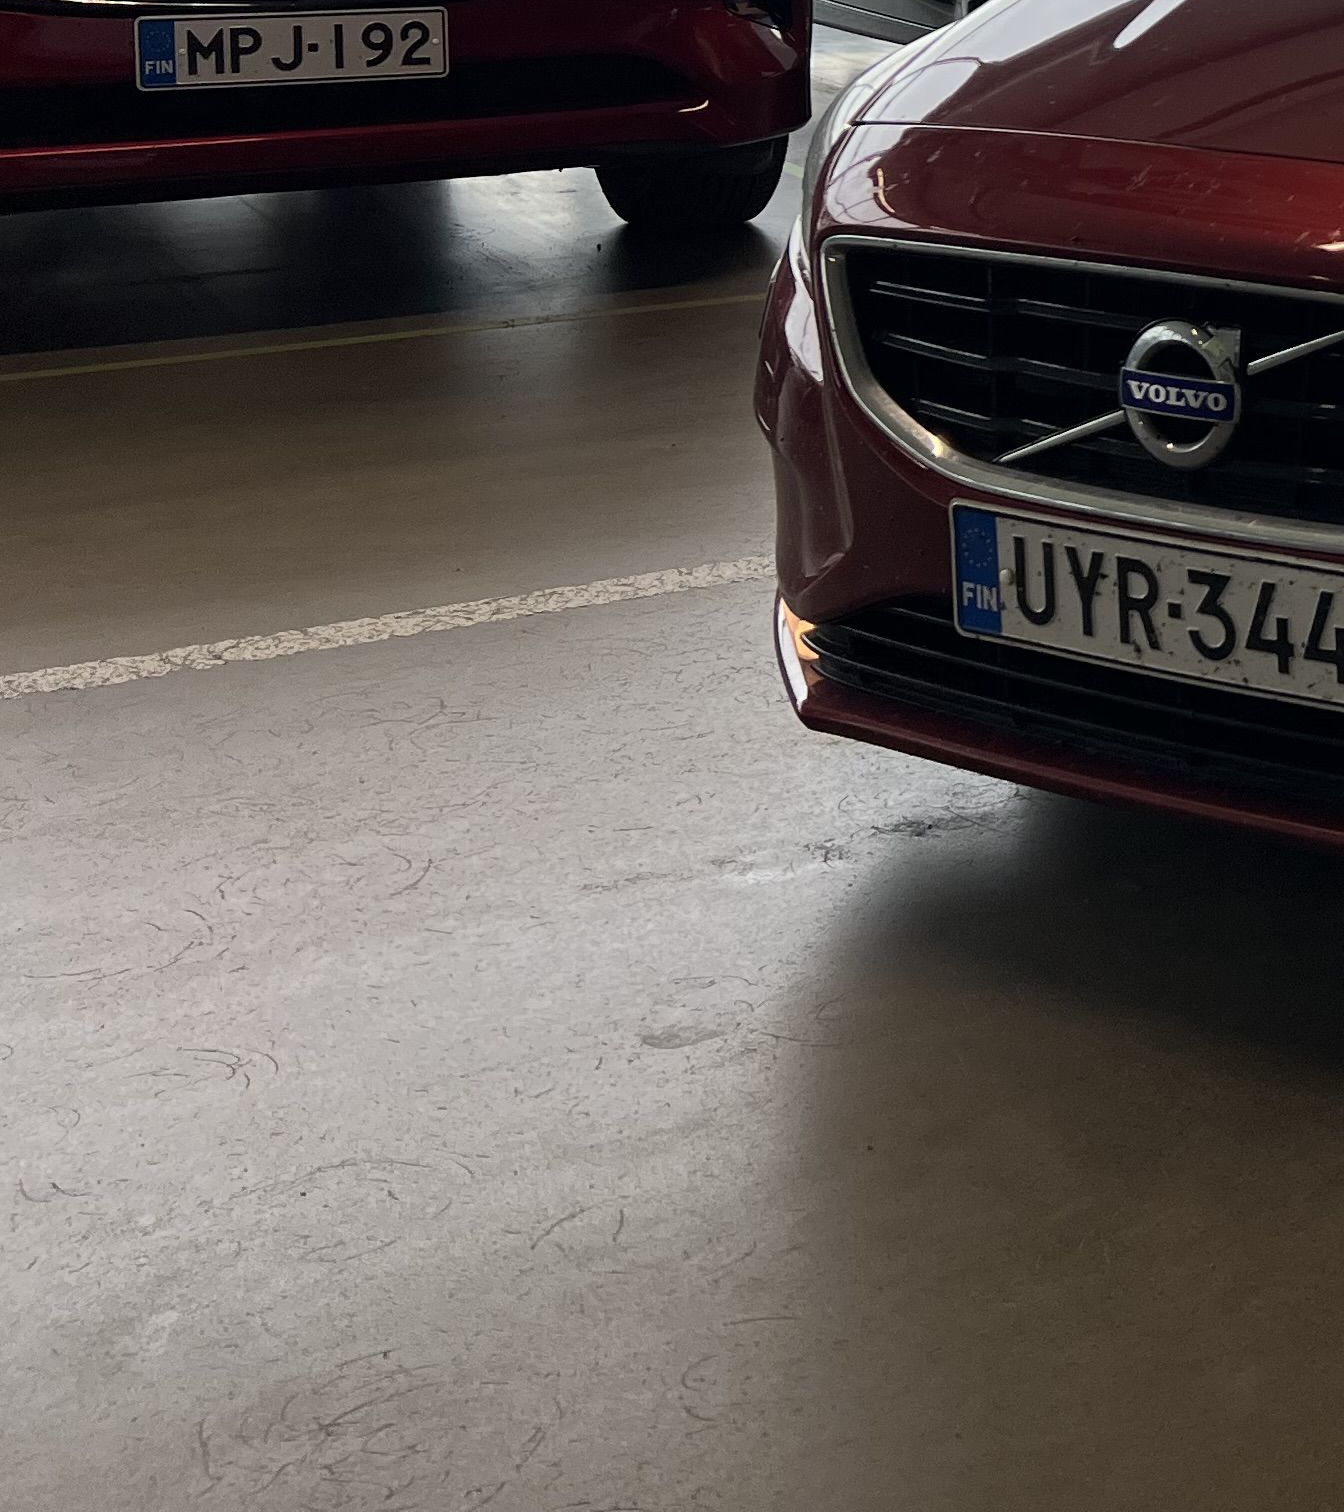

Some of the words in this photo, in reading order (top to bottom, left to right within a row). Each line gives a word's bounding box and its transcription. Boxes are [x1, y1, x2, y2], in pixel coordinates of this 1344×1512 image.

[144, 59, 174, 75] FIN
[186, 20, 432, 76] MPJ-192
[1127, 378, 1228, 413] VOLVO
[962, 581, 998, 613] FIN
